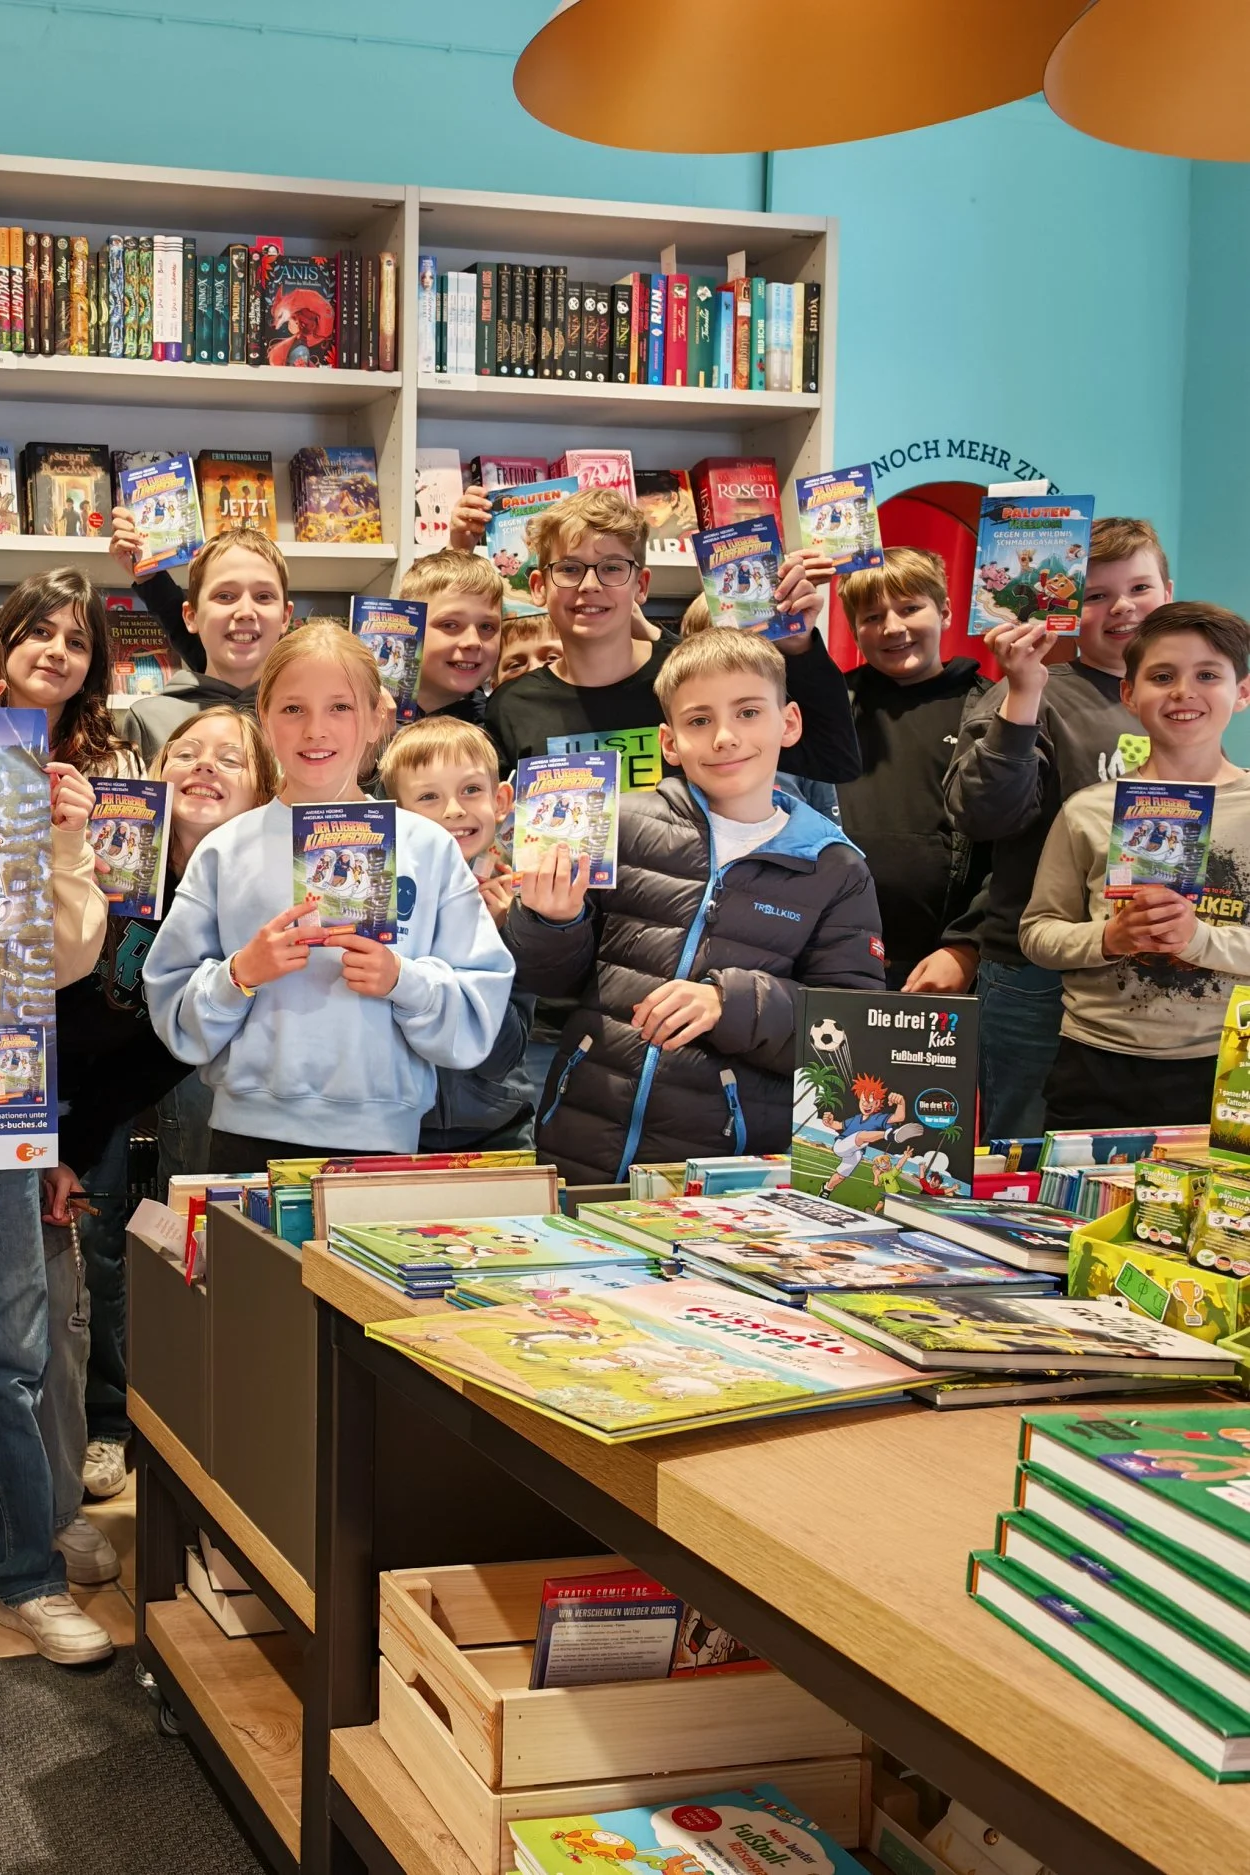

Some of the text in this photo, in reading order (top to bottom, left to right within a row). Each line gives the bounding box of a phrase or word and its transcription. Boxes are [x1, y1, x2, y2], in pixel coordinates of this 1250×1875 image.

[56, 256, 68, 285] Willow
[275, 266, 320, 282] ANIS
[11, 267, 24, 320] FOXLIGHT
[197, 278, 208, 313] ANIMOX
[214, 278, 226, 314] ANIMOX
[651, 288, 663, 325] RUN
[212, 452, 269, 462] ERIN ENTRADA KELLY
[872, 439, 940, 479] NOCH
[948, 438, 1012, 470] MEHR
[502, 490, 562, 508] PALUTEN
[221, 499, 269, 518] JETZT
[1002, 507, 1070, 520] PALUTEN
[111, 628, 164, 638] BIBLIOTHE
[122, 638, 164, 646] DER BUKS
[868, 1009, 958, 1031] Die drei ???
[928, 1032, 956, 1048] Kids
[892, 1050, 956, 1066] Fußball-Spione
[920, 1101, 928, 1109] Die
[930, 1101, 942, 1109] drei
[26, 1146, 48, 1157] ZDF
[1219, 1192, 1244, 1204] ganzer
[730, 1311, 753, 1319] DIE
[675, 1314, 806, 1350] SCHAFE
[686, 1307, 846, 1354] FUSSBALL
[1058, 1306, 1176, 1347] FREUNDE
[558, 1586, 648, 1598] GRATIS COMIC TAG
[574, 1607, 622, 1618] VERSCHENKEN
[624, 1606, 650, 1616] WIEDER
[650, 1605, 677, 1615] COMICS
[729, 1822, 792, 1868] Fußball-
[766, 1828, 818, 1865] Mein bunter
[727, 1841, 769, 1875] Rätselspa
